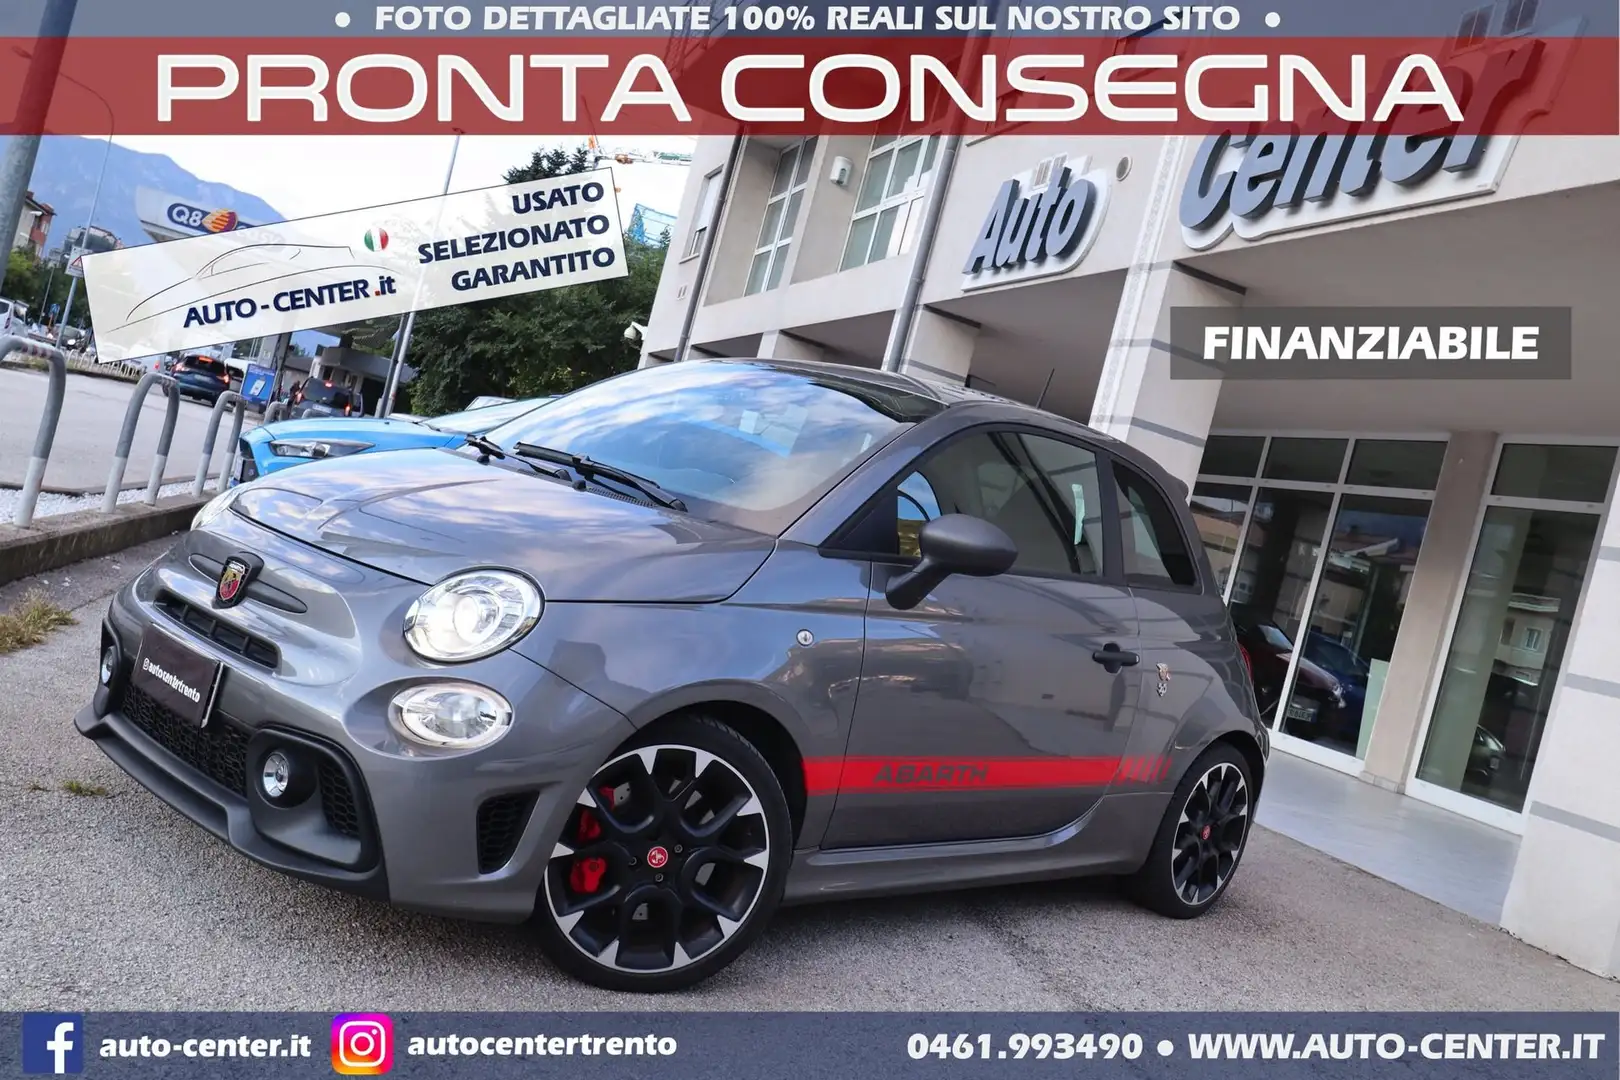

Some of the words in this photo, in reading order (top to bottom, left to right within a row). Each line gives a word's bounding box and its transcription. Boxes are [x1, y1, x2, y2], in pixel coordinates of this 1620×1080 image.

[172, 205, 203, 227] Q8
[962, 166, 1098, 275] Auto
[142, 657, 201, 703] @autocentertrento
[873, 764, 989, 784] ABARTH
